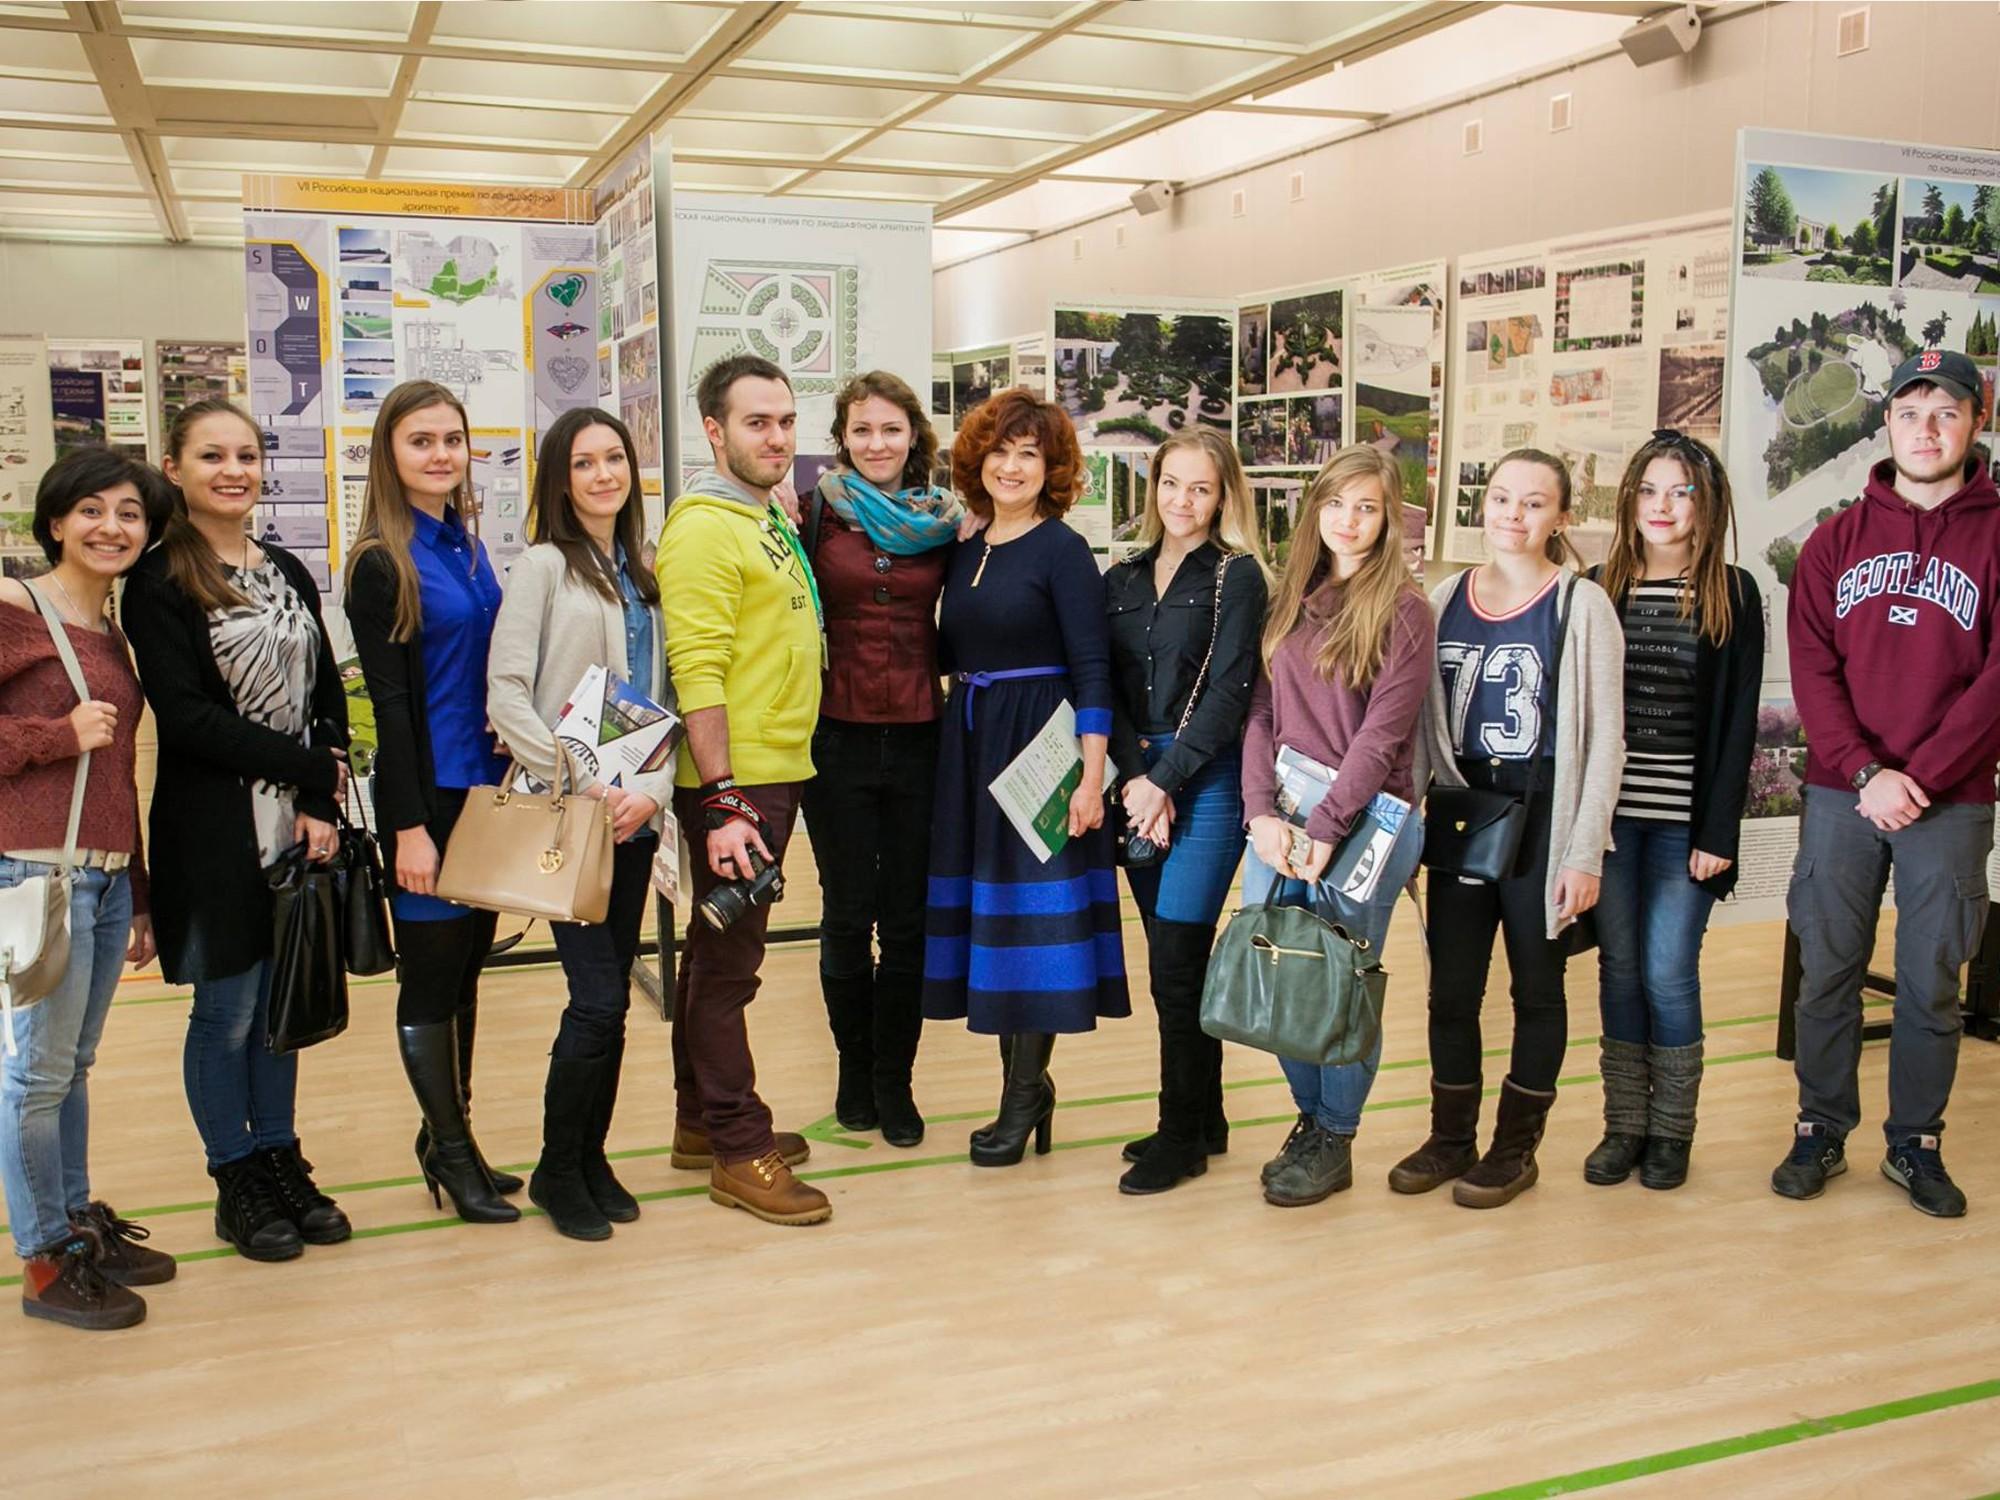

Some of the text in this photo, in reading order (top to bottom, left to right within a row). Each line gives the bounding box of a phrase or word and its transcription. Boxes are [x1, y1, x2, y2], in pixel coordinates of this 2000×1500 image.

[311, 181, 368, 194] Российская
[252, 250, 263, 265] S
[295, 295, 310, 312] W
[1916, 351, 1943, 372] B
[299, 382, 308, 398] T
[1836, 552, 1979, 630] SCOTLAND
[1640, 608, 1660, 616] LIFE
[1641, 625, 1652, 633] IS
[1438, 641, 1543, 759] 73
